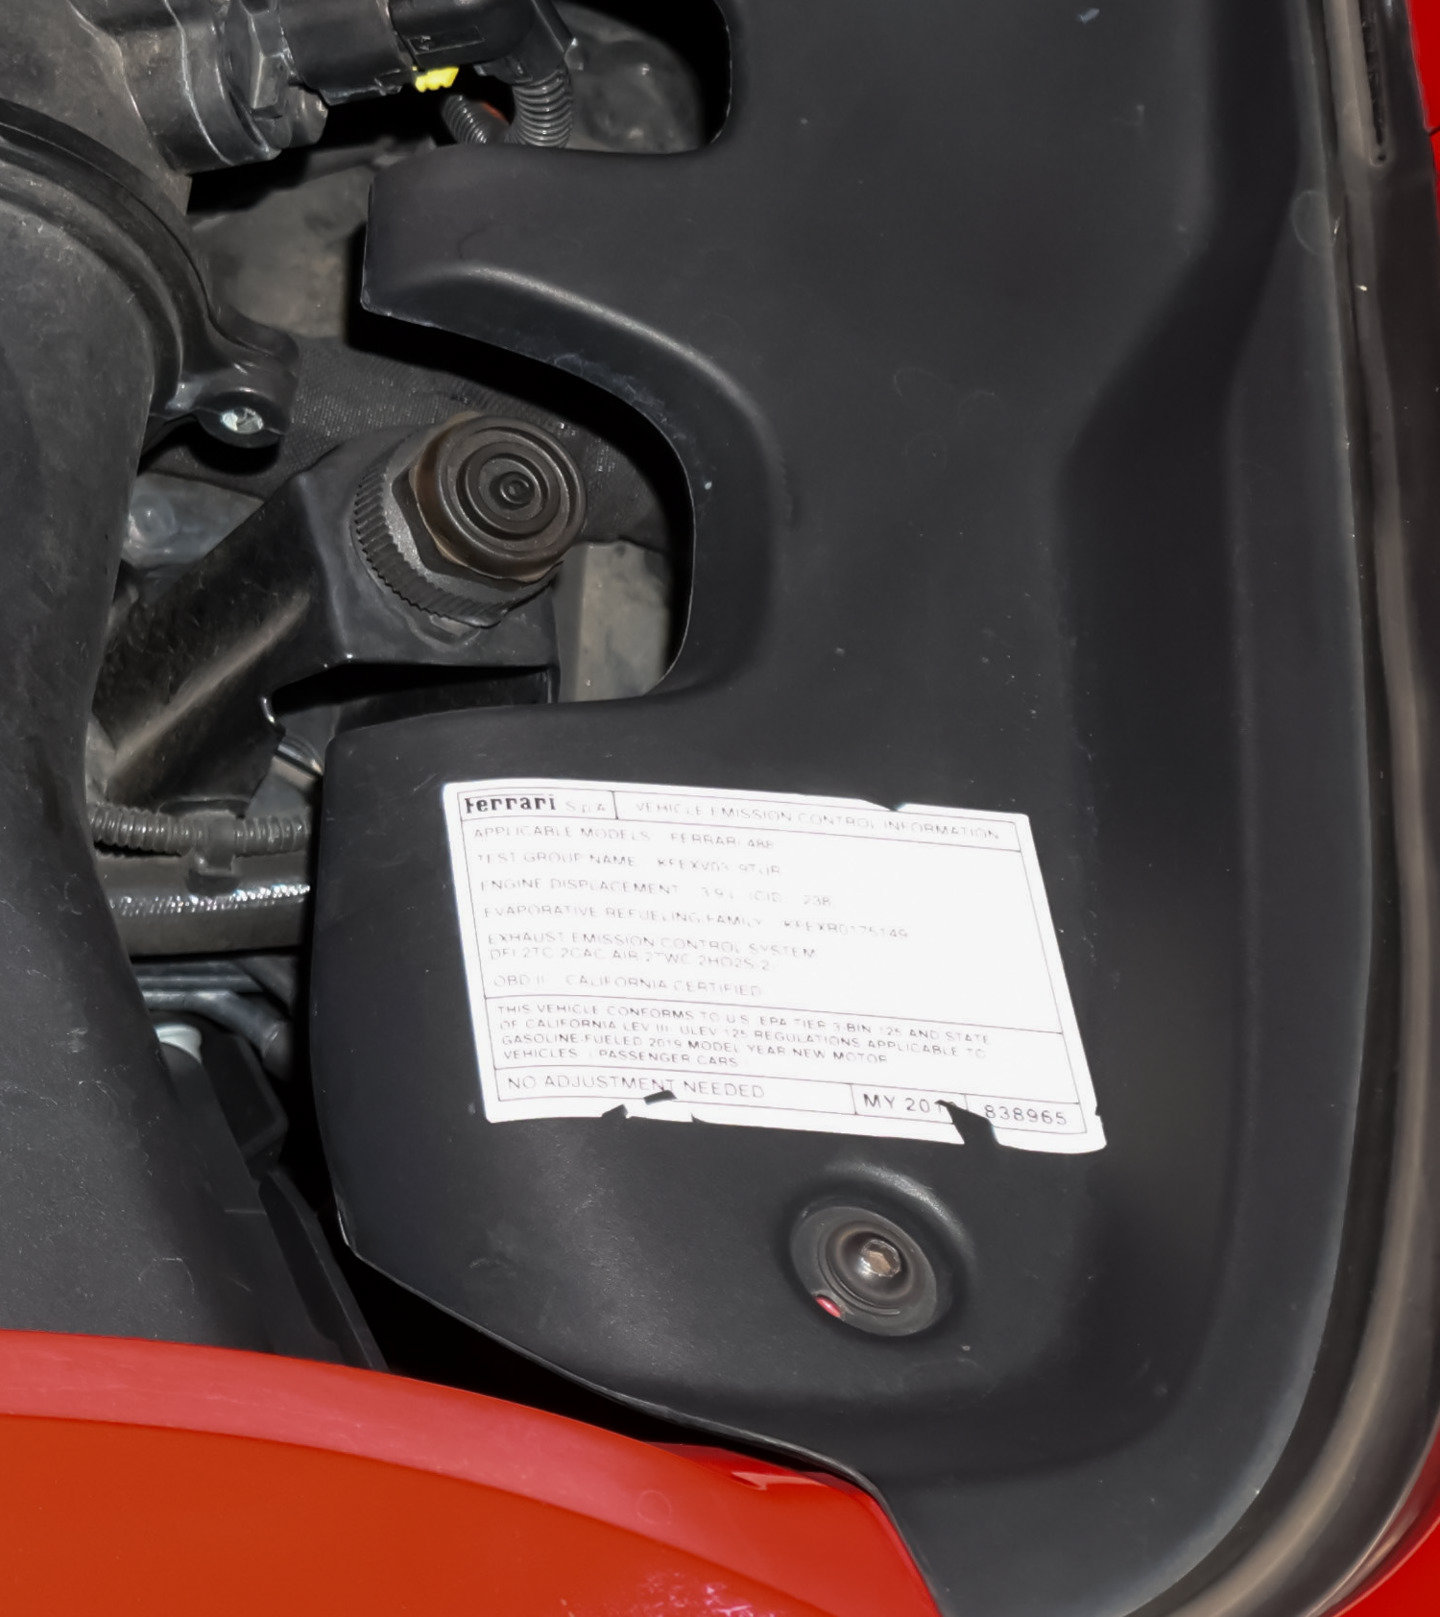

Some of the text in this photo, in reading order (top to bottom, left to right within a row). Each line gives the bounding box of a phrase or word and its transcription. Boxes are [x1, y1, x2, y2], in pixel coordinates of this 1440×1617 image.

[464, 794, 557, 814] Ferrari
[711, 806, 792, 821] EMISSION
[572, 933, 654, 947] EMISSION
[497, 1004, 530, 1014] THIS
[537, 1004, 599, 1015] VEHICLE
[607, 1005, 694, 1020] CONFORMS
[760, 1015, 787, 1027] EPA
[909, 1028, 940, 1040] AND
[526, 1019, 616, 1030] CALIFORNIA
[748, 1045, 786, 1056] YEAR
[793, 1047, 825, 1059] NEW
[697, 1054, 739, 1068] CARS
[508, 1074, 765, 1098] NO ADJUSTMENT NEEDED
[864, 1093, 896, 1109] MY
[984, 1104, 1067, 1125] 838965
